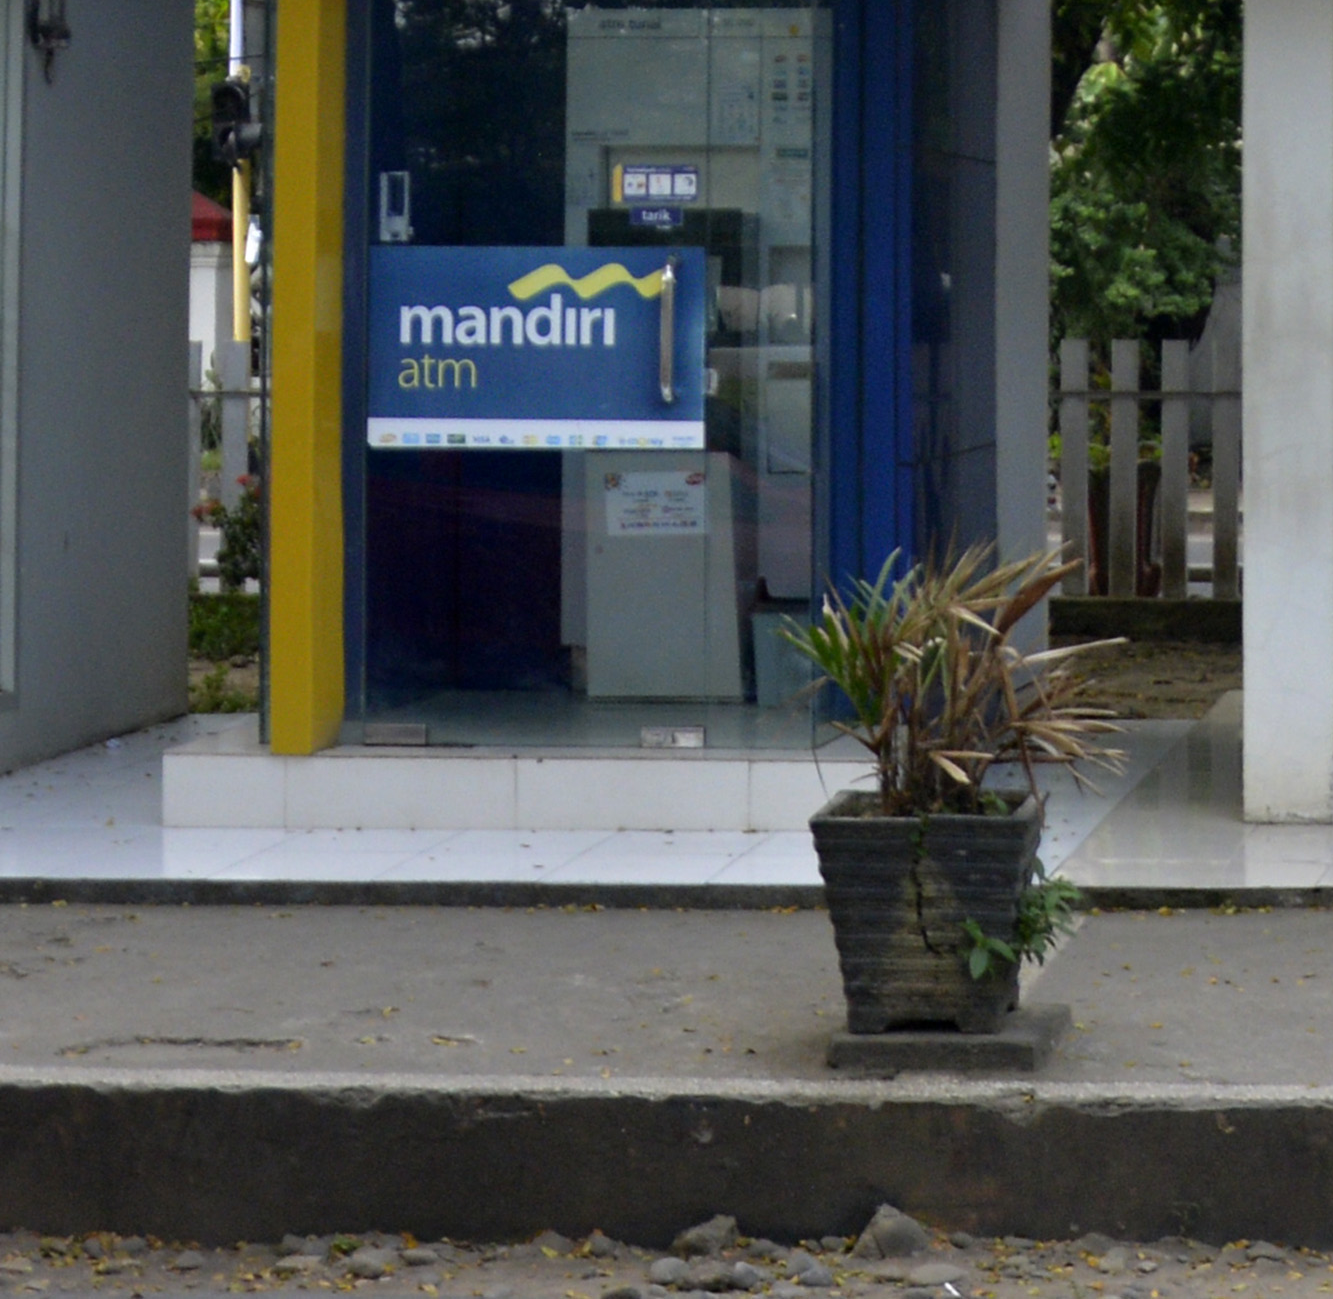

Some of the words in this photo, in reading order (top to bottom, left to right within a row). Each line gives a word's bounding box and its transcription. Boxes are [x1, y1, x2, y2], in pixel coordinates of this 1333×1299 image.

[642, 209, 672, 221] tarik
[400, 294, 615, 346] mandiri
[398, 354, 477, 388] atm
